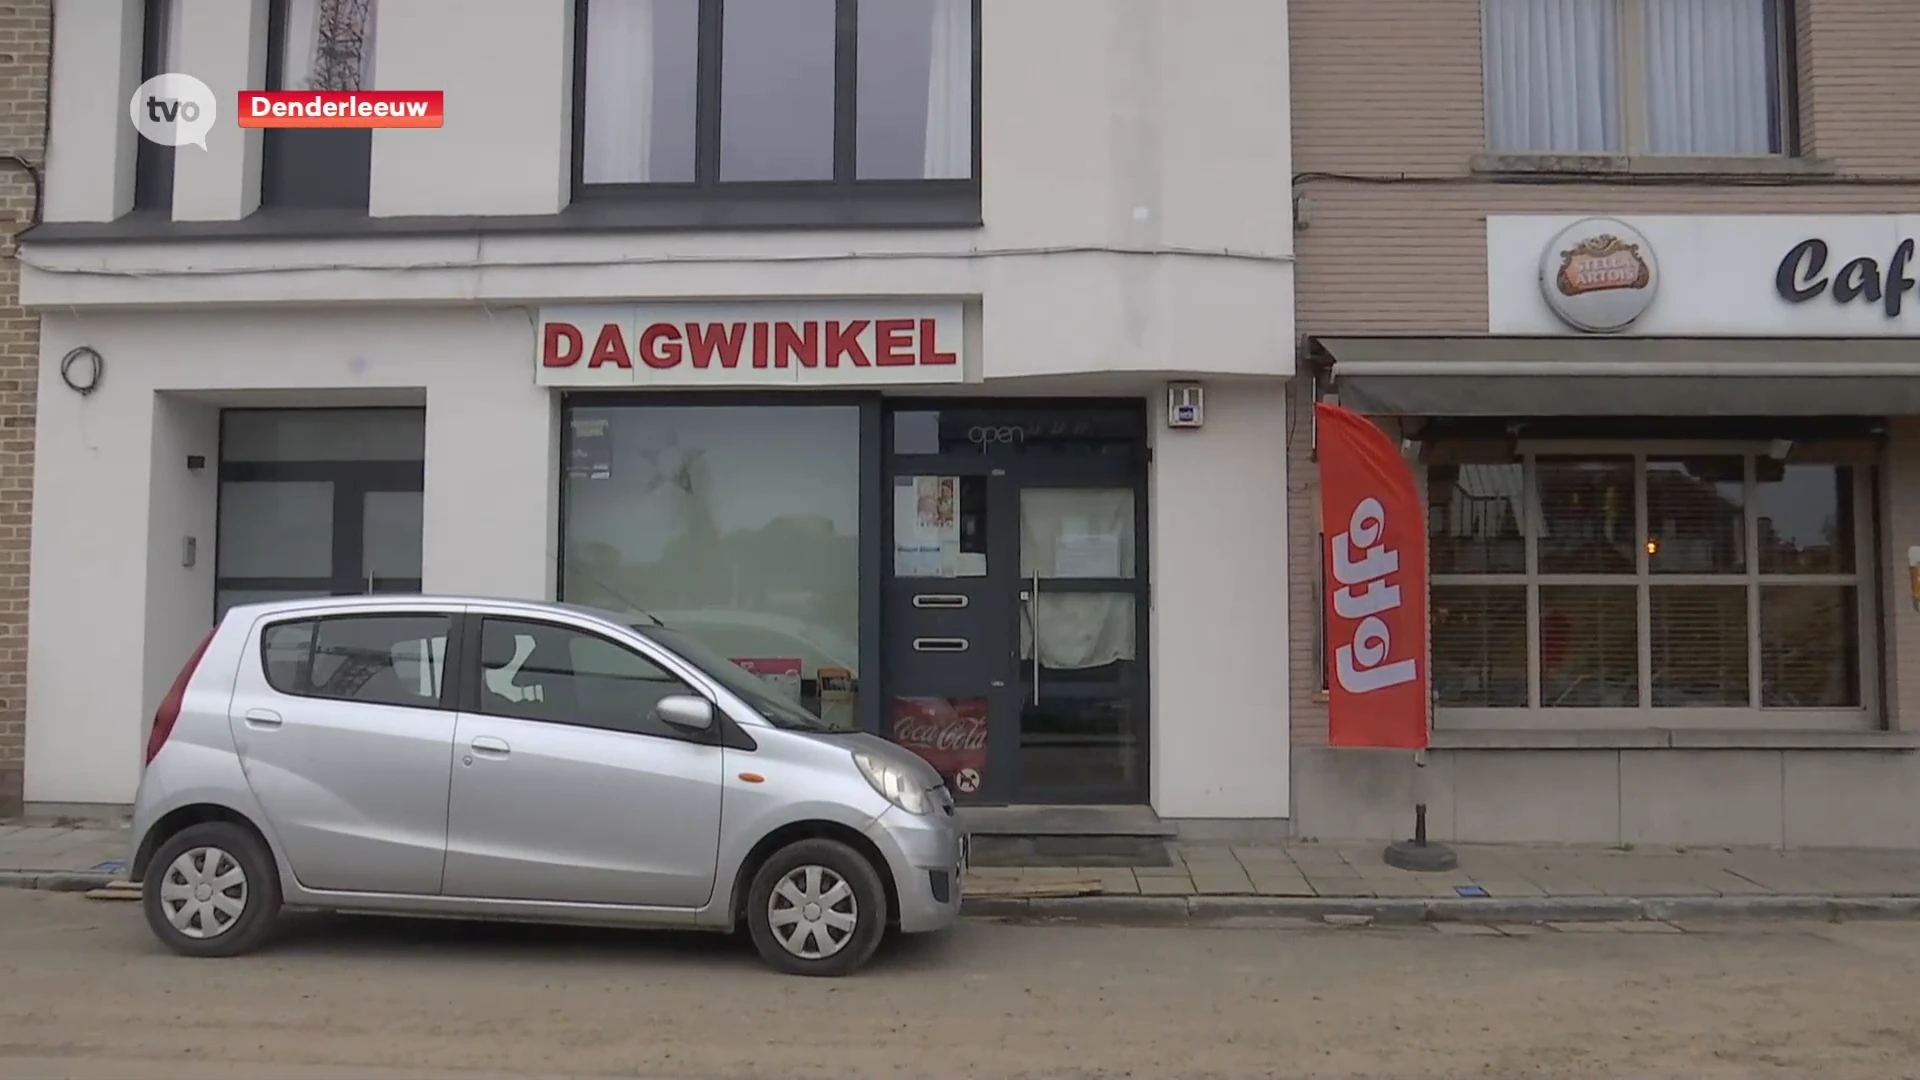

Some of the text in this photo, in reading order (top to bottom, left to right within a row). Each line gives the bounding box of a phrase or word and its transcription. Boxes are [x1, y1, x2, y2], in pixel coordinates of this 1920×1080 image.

[1577, 257, 1637, 271] STELLA
[1577, 268, 1636, 284] ARTOIS
[1776, 238, 1920, 317] Caf
[543, 319, 957, 368] DAGWINKEL
[968, 426, 1024, 455] open
